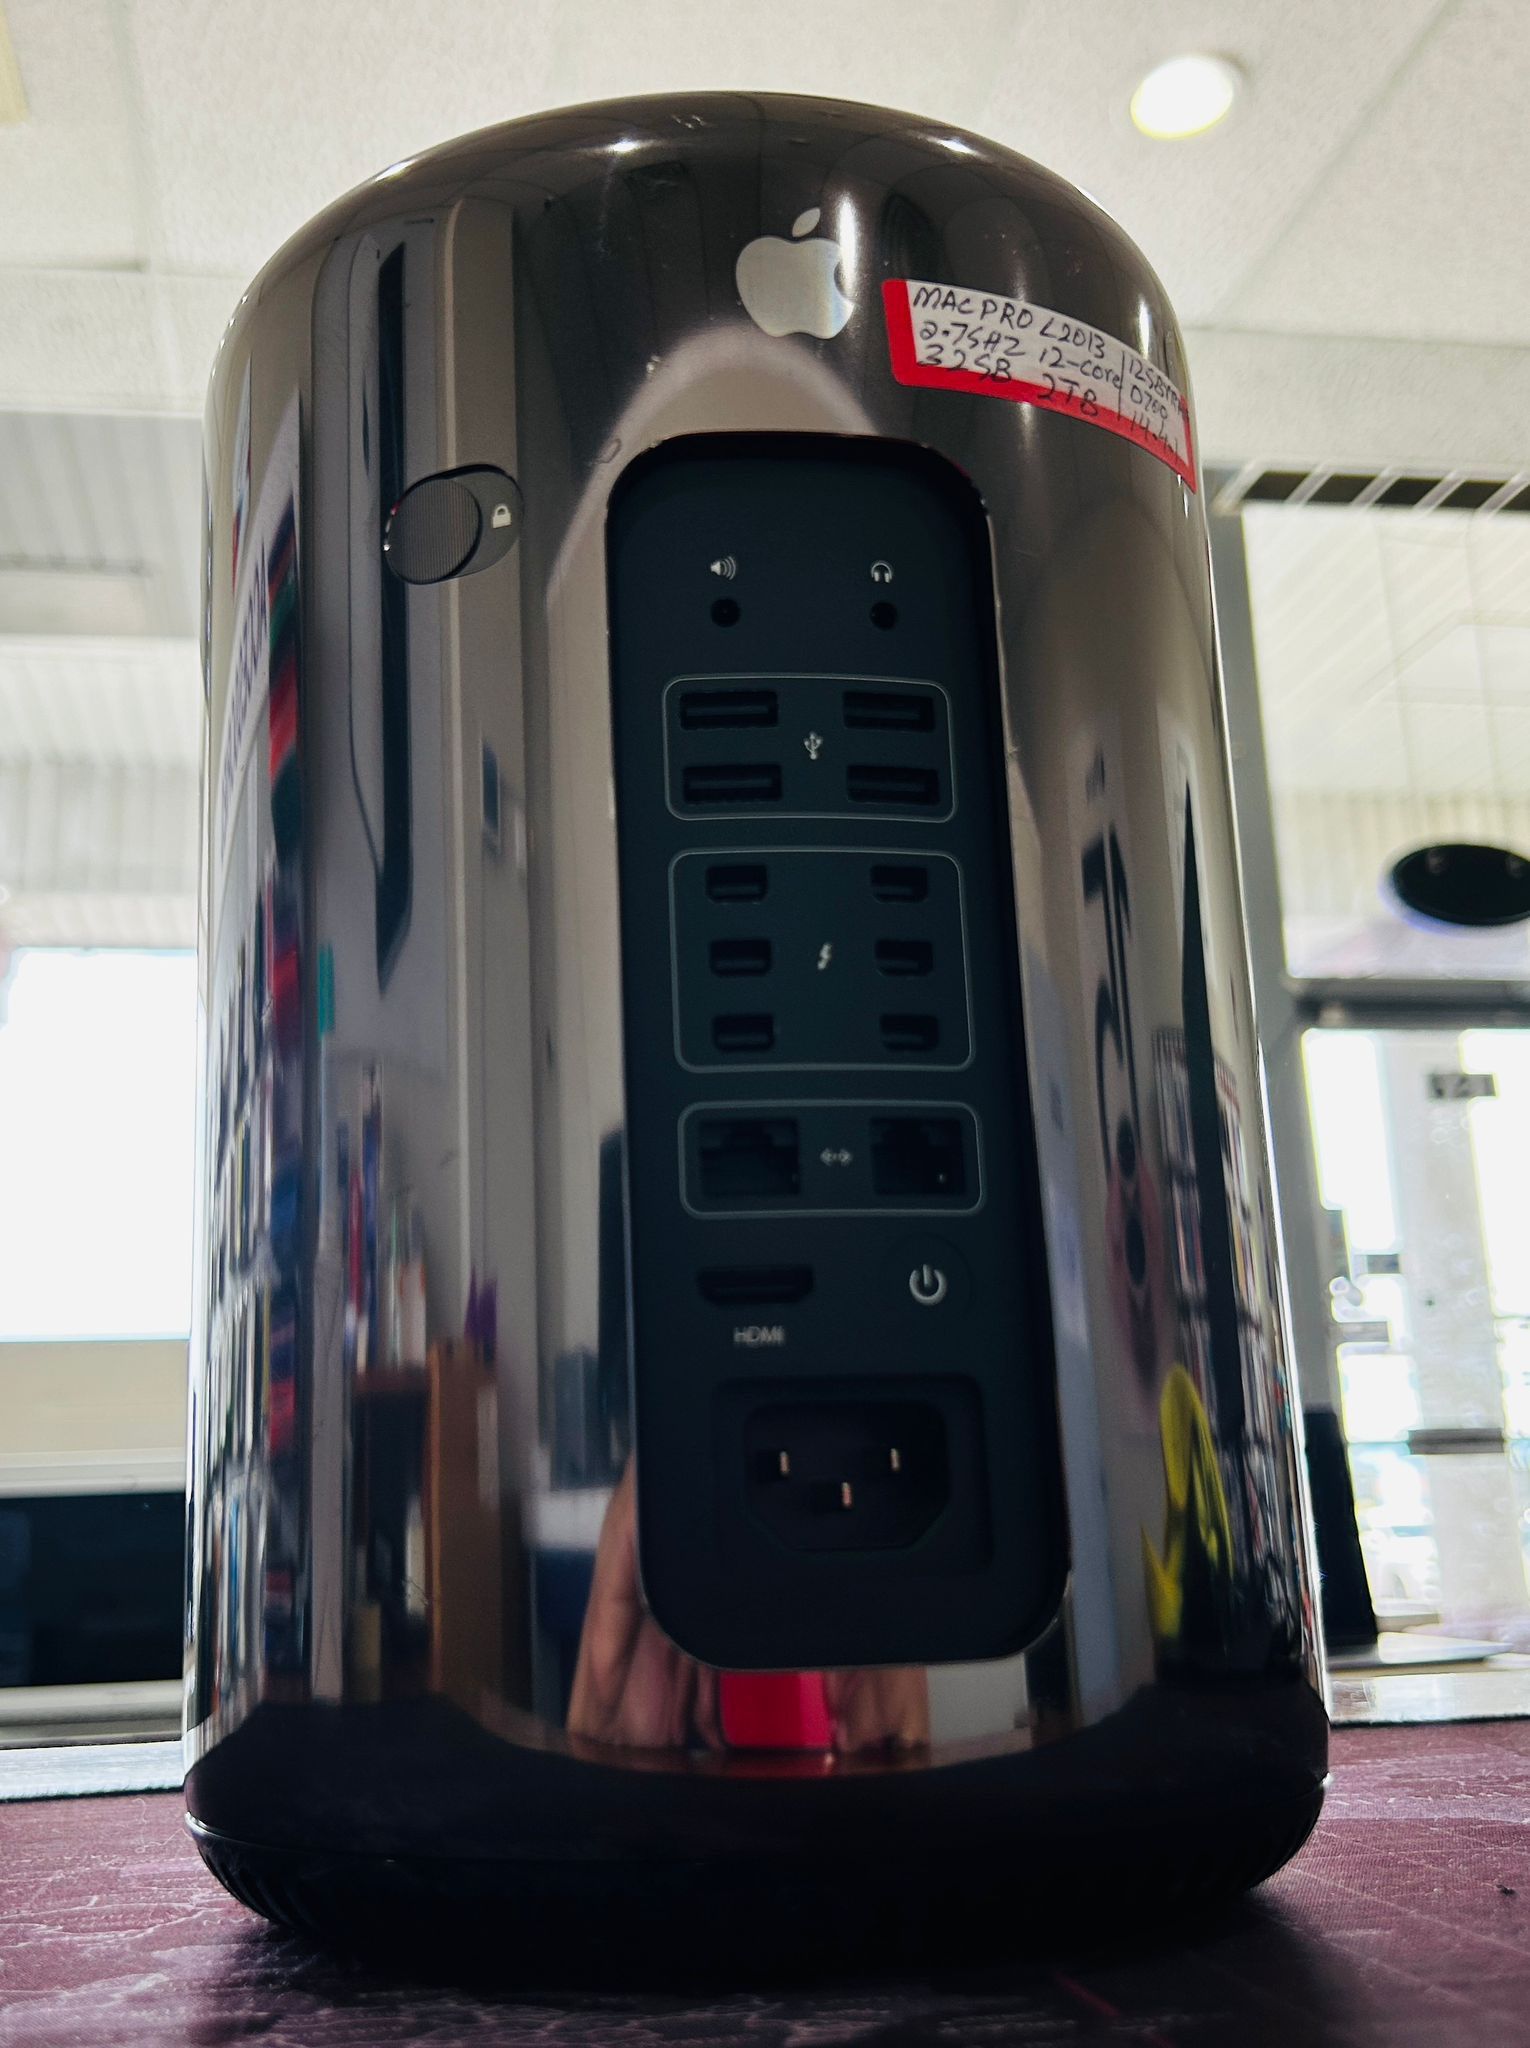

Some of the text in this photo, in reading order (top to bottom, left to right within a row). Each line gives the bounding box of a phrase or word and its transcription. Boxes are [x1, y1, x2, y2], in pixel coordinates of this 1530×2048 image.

[913, 287, 1106, 359] MAC PRO L2013
[1037, 373, 1098, 417] 2TB
[733, 1326, 785, 1344] HDMI
